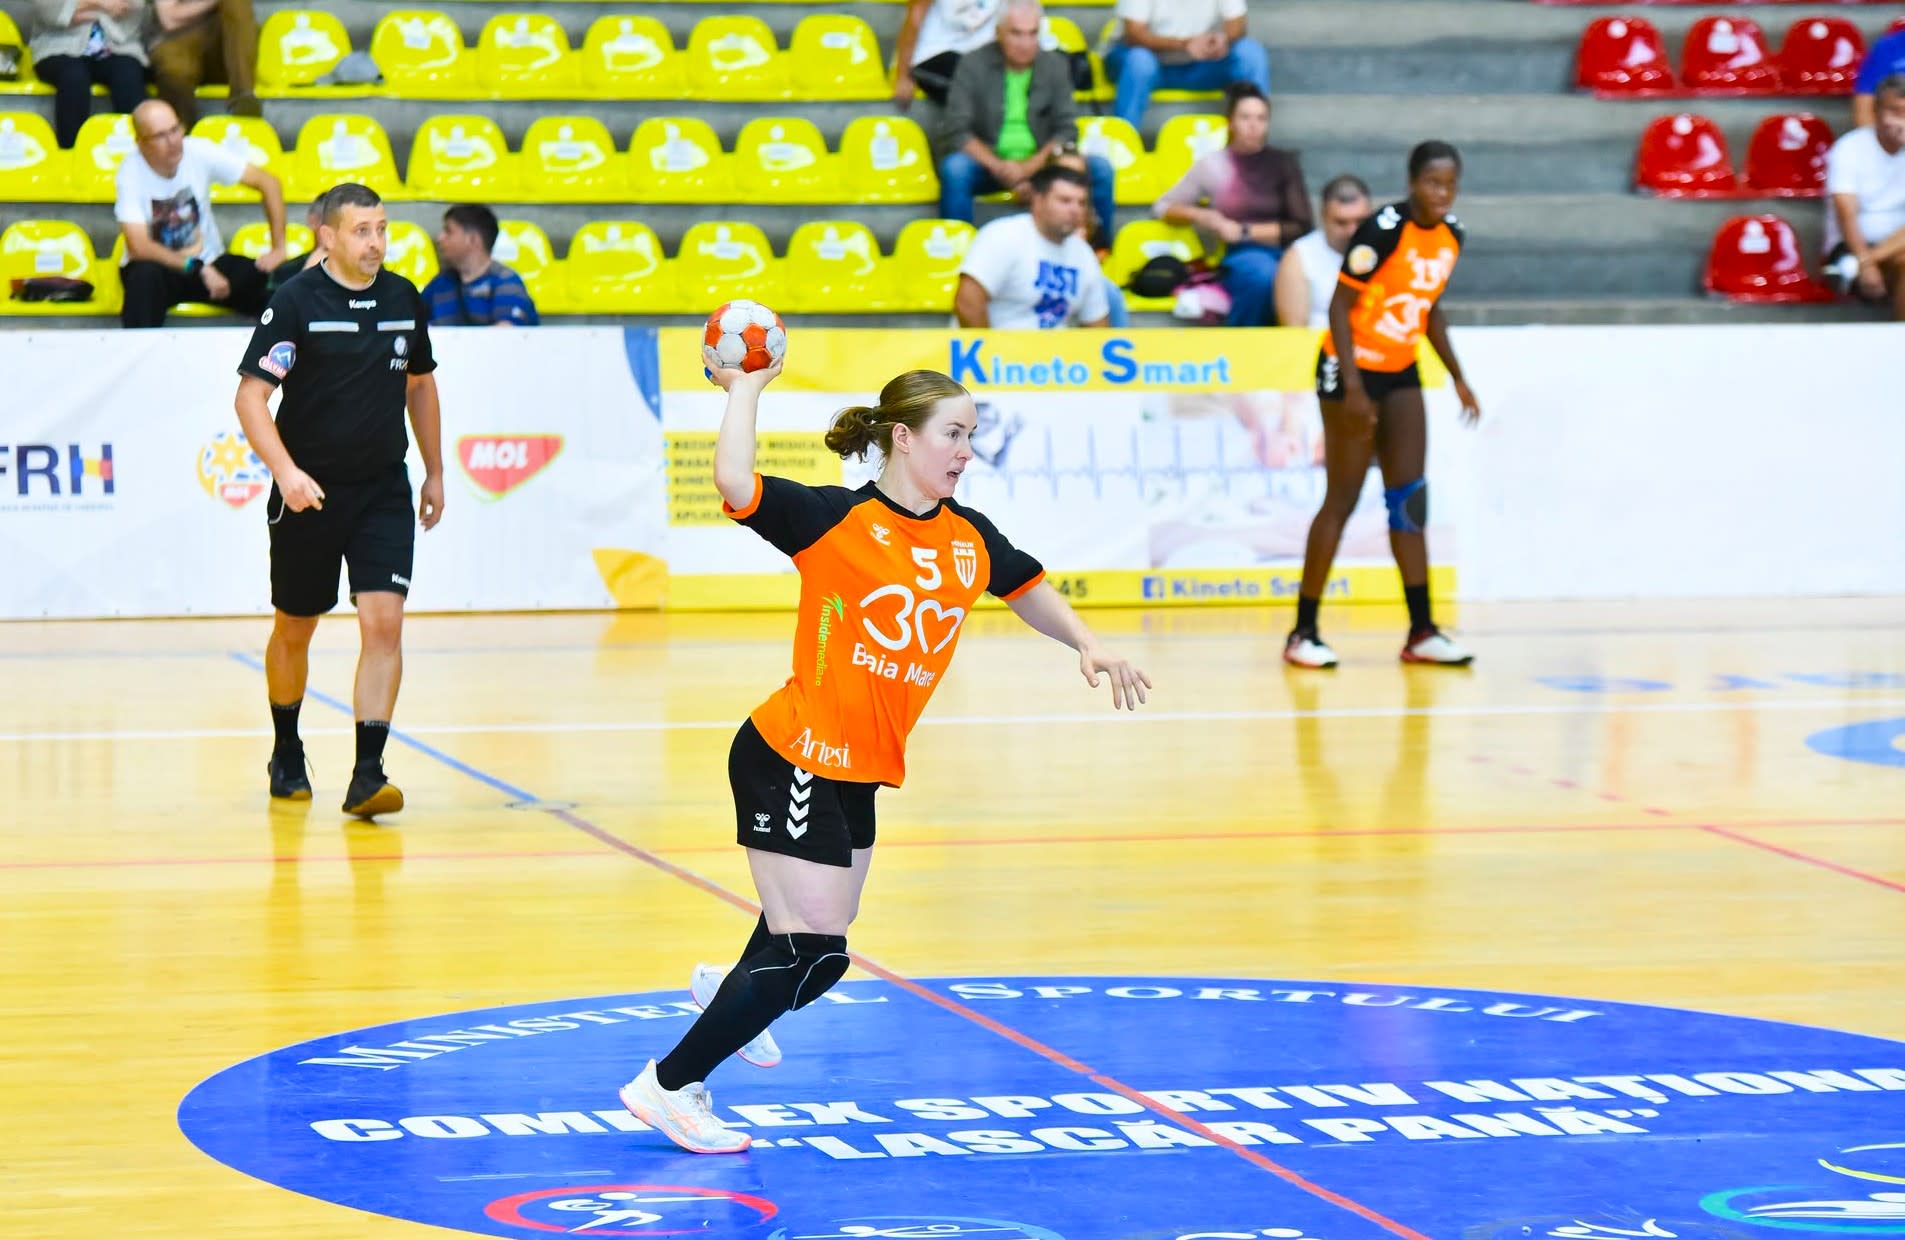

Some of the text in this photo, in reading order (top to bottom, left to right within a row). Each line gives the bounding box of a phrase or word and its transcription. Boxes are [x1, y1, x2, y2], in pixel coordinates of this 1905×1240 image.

[950, 339, 1231, 385] Kineto Smart
[469, 441, 528, 470] MOL
[911, 546, 942, 591] 5
[1173, 577, 1260, 597] Kineto
[1270, 576, 1350, 597] Smrt
[852, 642, 936, 688] Baia Mare
[297, 983, 1606, 1072] MINISTEL SPORTULUI
[894, 1083, 1421, 1121] SPORTIV
